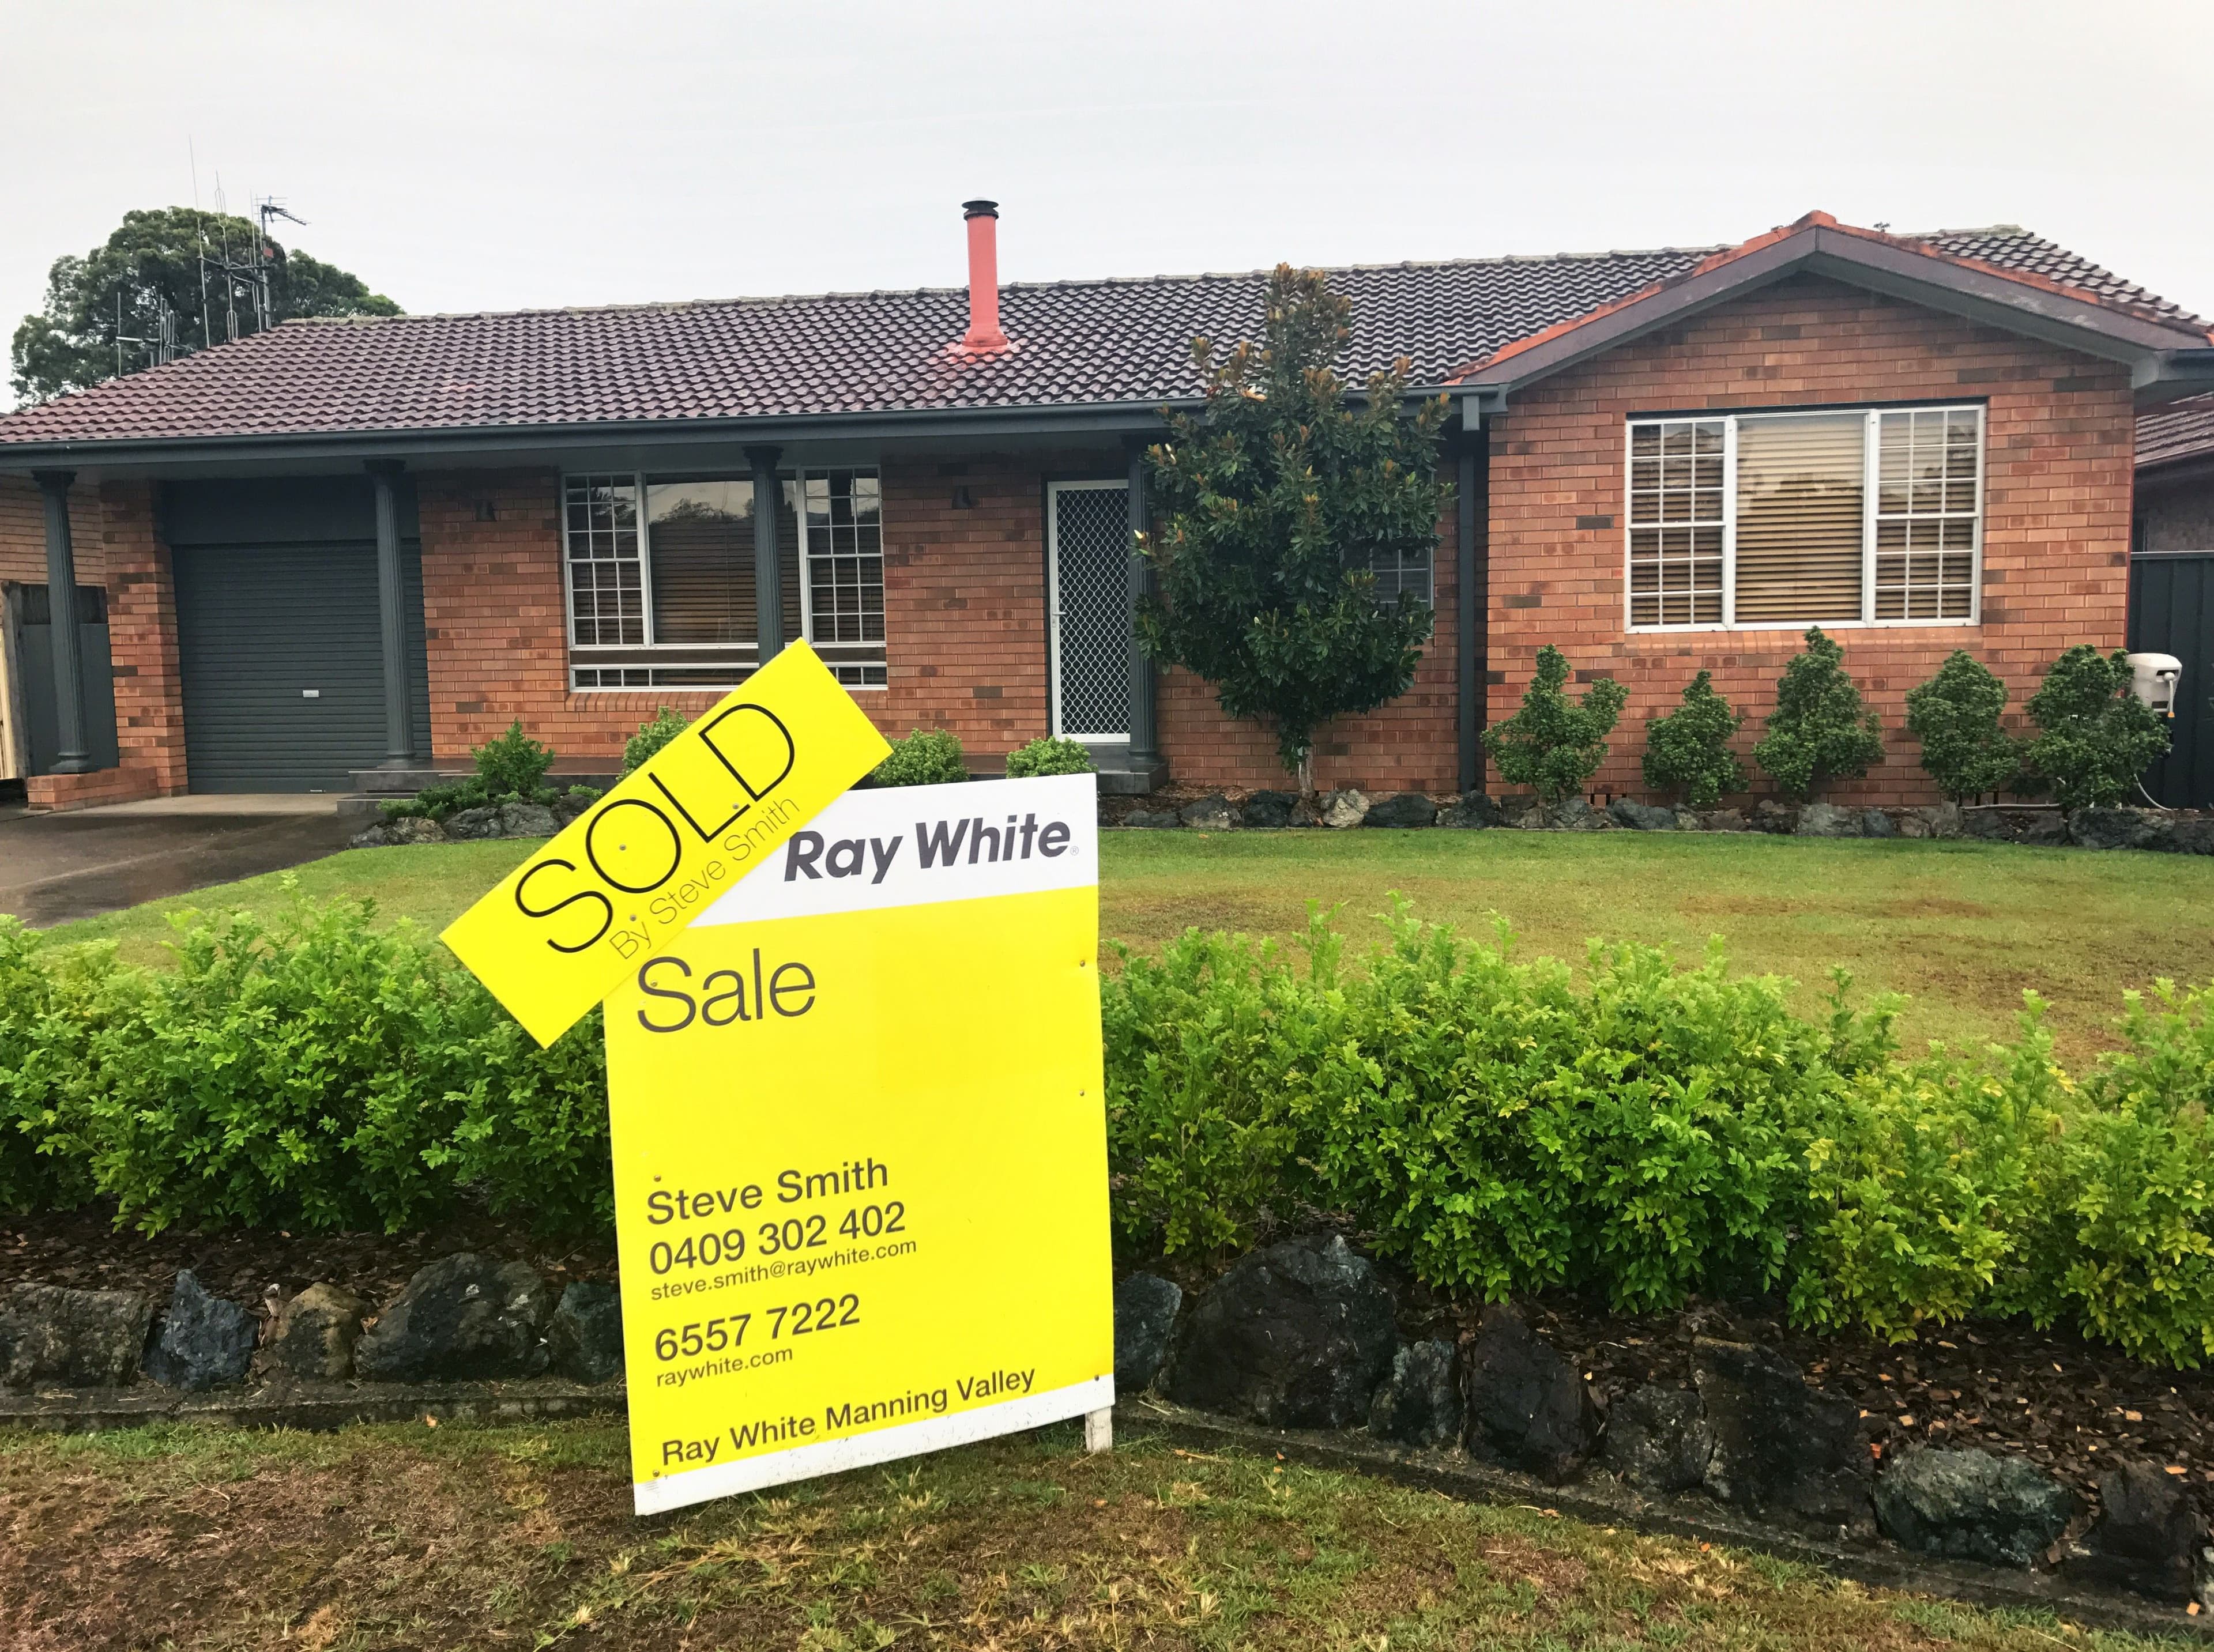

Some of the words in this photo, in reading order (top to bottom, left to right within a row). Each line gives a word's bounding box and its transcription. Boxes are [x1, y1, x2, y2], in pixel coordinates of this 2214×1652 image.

[515, 703, 795, 953] SOLD
[784, 830, 903, 885] Ray
[609, 921, 651, 960] By
[649, 859, 725, 925] Steve
[723, 795, 800, 862] Smith
[637, 948, 816, 1034] Sale
[647, 1184, 763, 1225] Steve
[777, 1157, 888, 1203] Smith
[650, 1228, 745, 1275] 0409
[758, 1215, 827, 1255] 302
[839, 1201, 905, 1240] 402
[651, 1240, 917, 1300] steve.smith@raywhite.com
[655, 1313, 751, 1361] 6557
[766, 1293, 860, 1340] 7222
[657, 1348, 793, 1387] raywhite.com
[662, 1436, 720, 1466] Ray
[729, 1416, 815, 1450] White
[826, 1389, 947, 1431] Manning
[956, 1368, 1035, 1401] Valley
